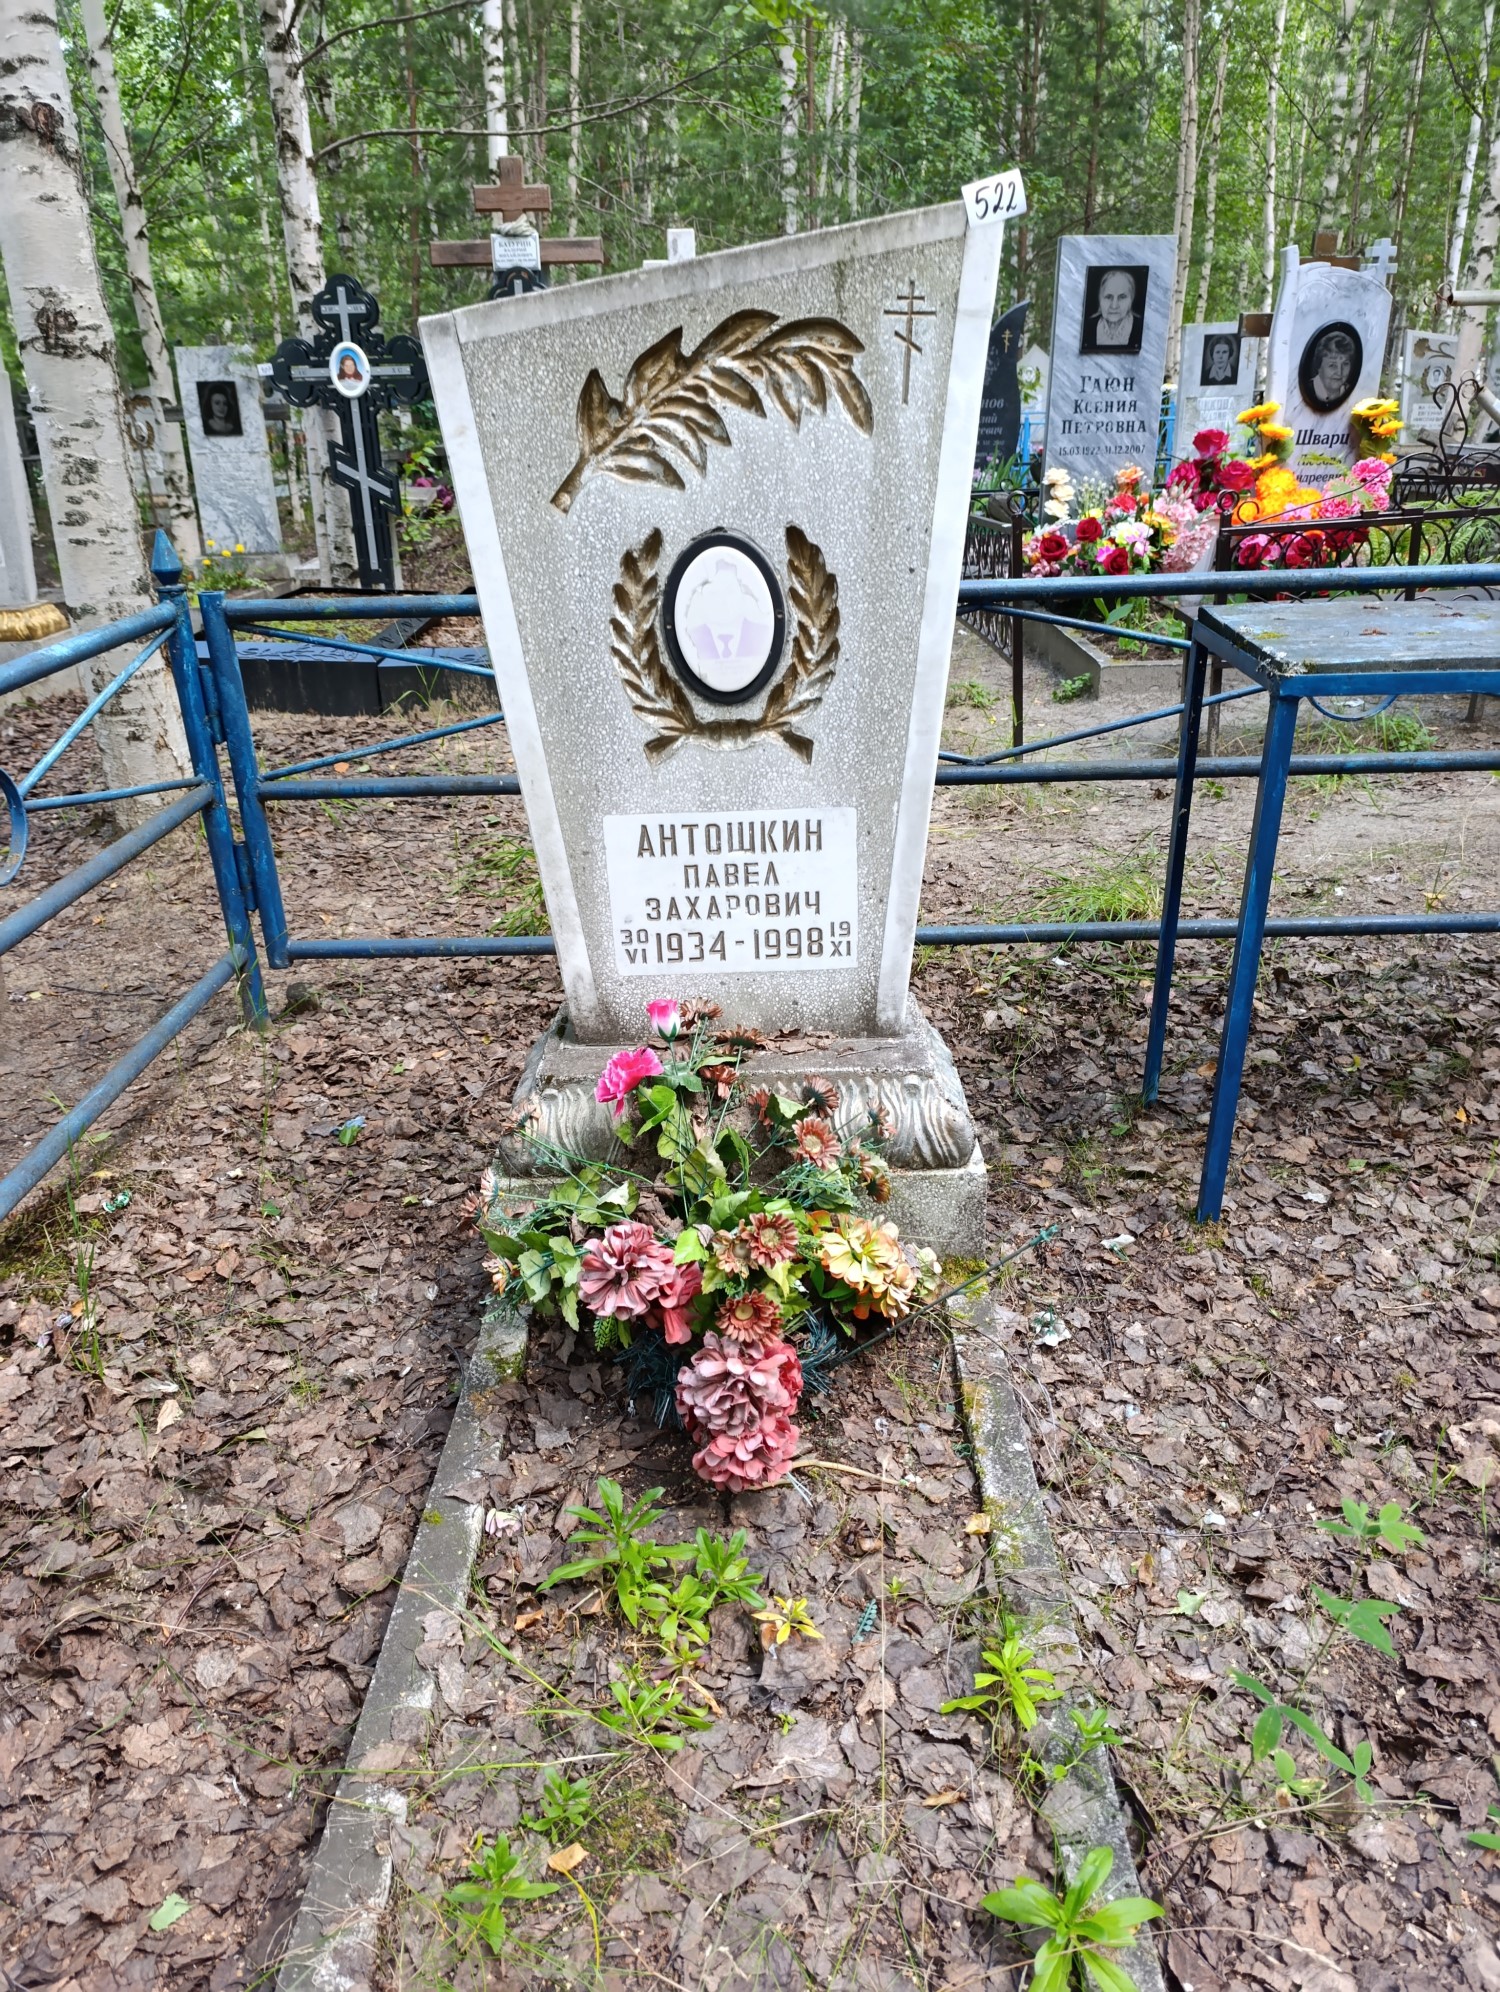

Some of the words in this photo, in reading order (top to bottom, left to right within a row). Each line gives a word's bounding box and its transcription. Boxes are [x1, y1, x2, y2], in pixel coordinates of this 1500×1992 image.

[975, 181, 1017, 220] 522
[1079, 375, 1135, 393] ГАЮН
[1073, 399, 1137, 415] КСЕНИЯ
[1061, 419, 1147, 435] ПЕТРОВНА
[637, 819, 822, 858] АНТОШКИН
[684, 861, 779, 889] ПАВЕЛ
[645, 890, 820, 921] ЗАХАРОВИЧ
[620, 928, 649, 945] 30
[830, 921, 851, 937] 19
[625, 948, 648, 964] VI
[829, 940, 851, 958] XI
